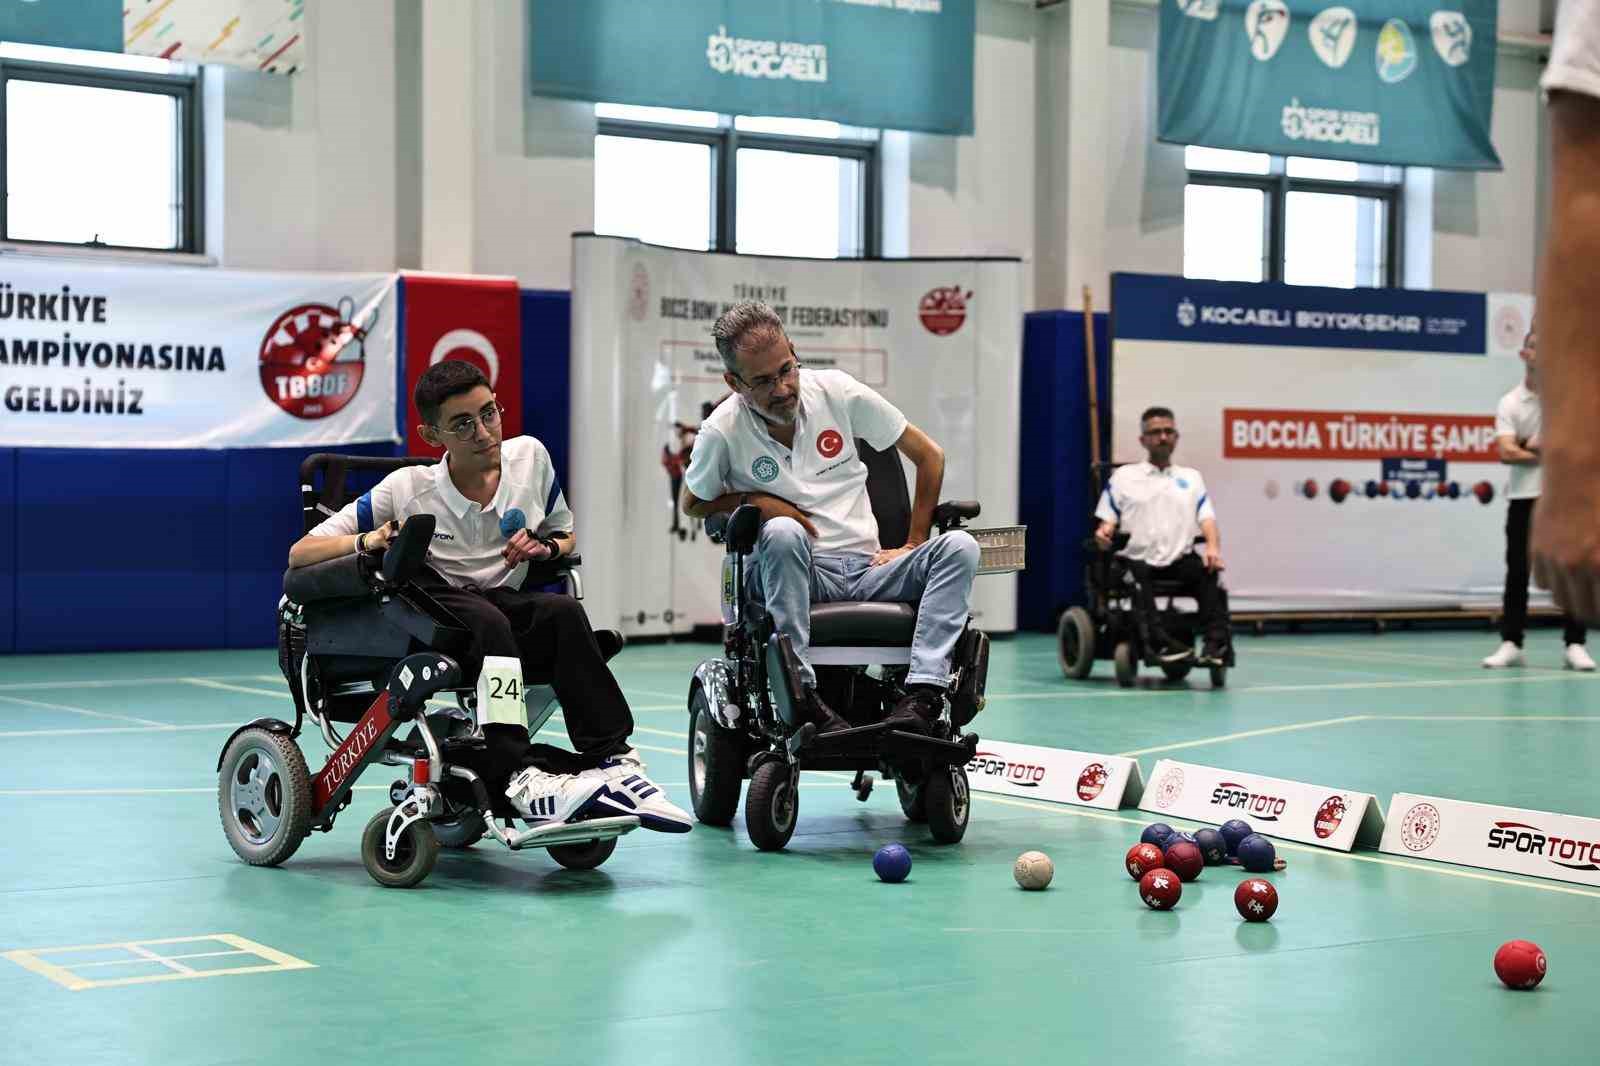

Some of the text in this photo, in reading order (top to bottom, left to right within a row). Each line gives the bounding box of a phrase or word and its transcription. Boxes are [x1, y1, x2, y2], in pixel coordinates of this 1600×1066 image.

[791, 306, 888, 328] FEDERASYONU
[4, 377, 144, 415] GELDİNİZ
[1231, 418, 1322, 449] BOCCIA
[1326, 414, 1427, 451] TÜRKİYE
[323, 717, 377, 793] TÜRKİYE
